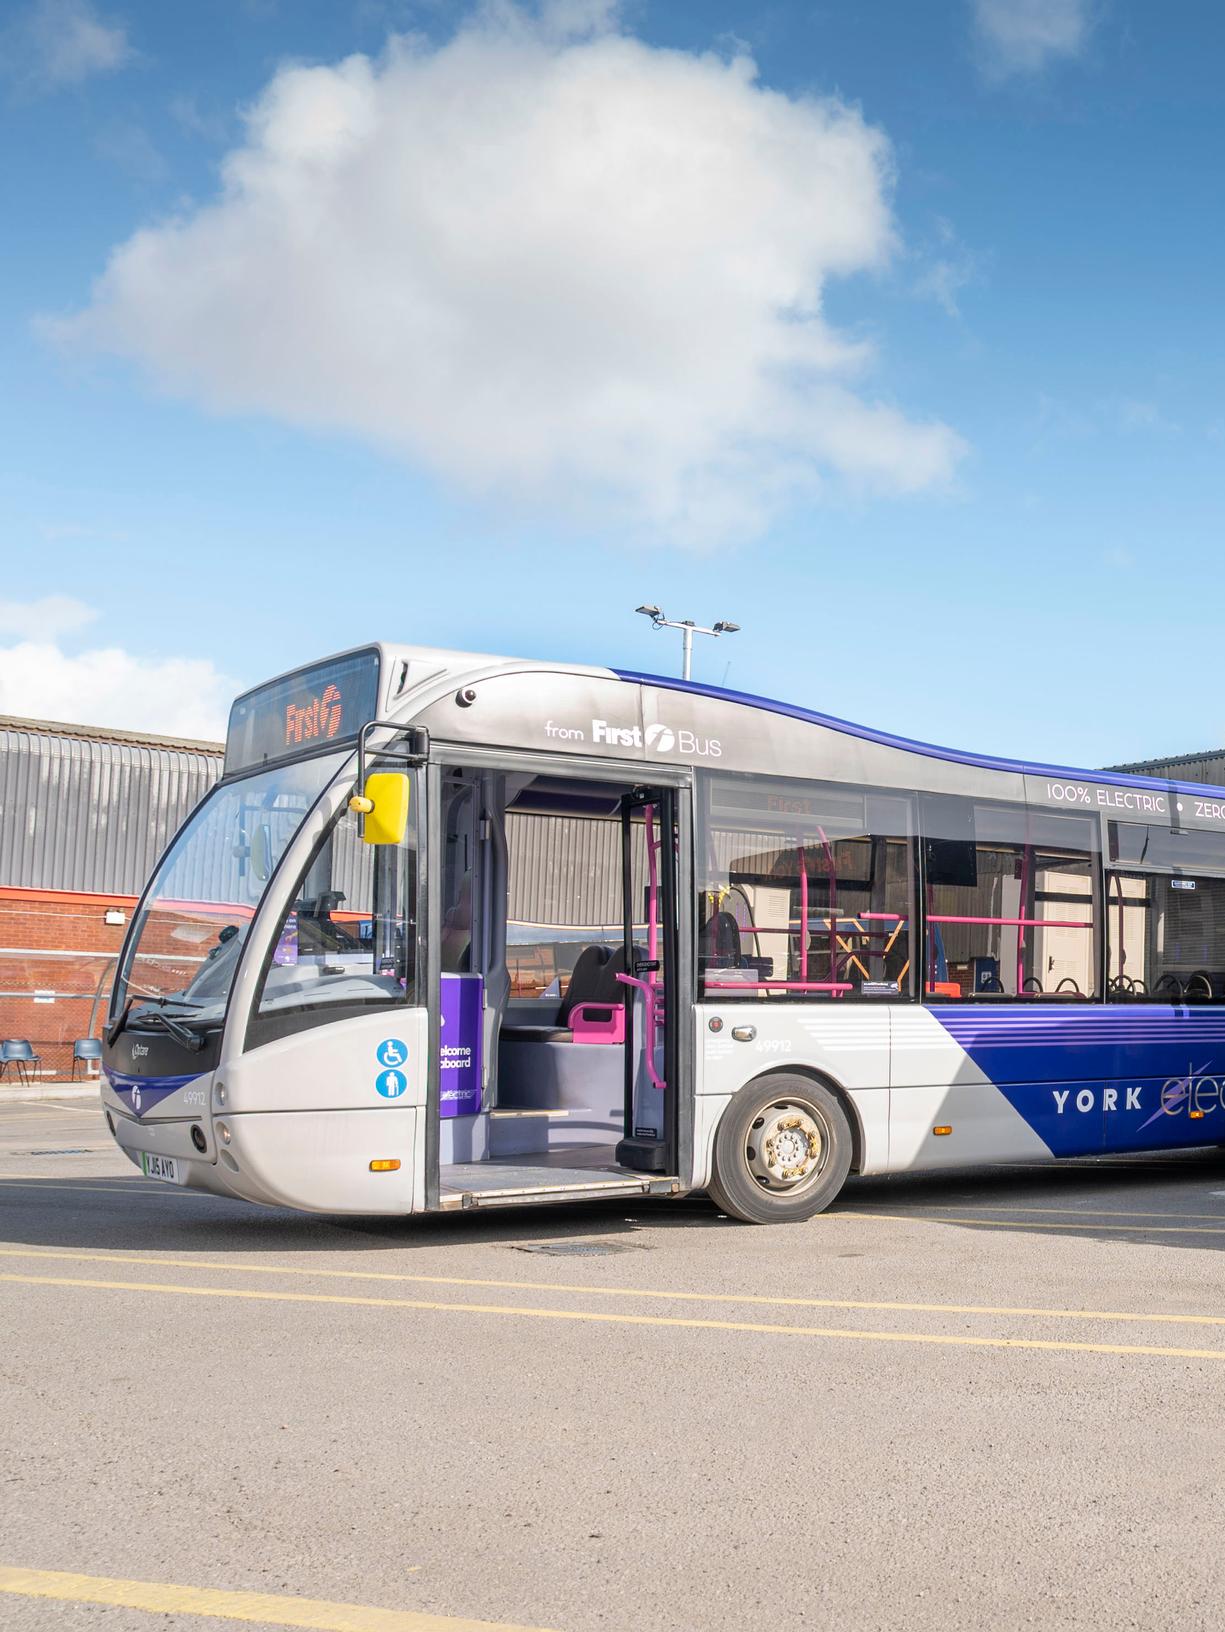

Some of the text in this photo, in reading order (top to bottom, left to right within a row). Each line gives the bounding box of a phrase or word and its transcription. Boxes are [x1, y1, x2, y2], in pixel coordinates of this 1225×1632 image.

[285, 697, 320, 745] First
[544, 719, 722, 757] from First Bus
[1047, 783, 1166, 813] 100% ELECTRIC
[440, 1045, 471, 1056] elcome
[755, 1039, 792, 1052] 49912
[183, 1091, 206, 1106] 49912
[1052, 1086, 1143, 1114] YORK
